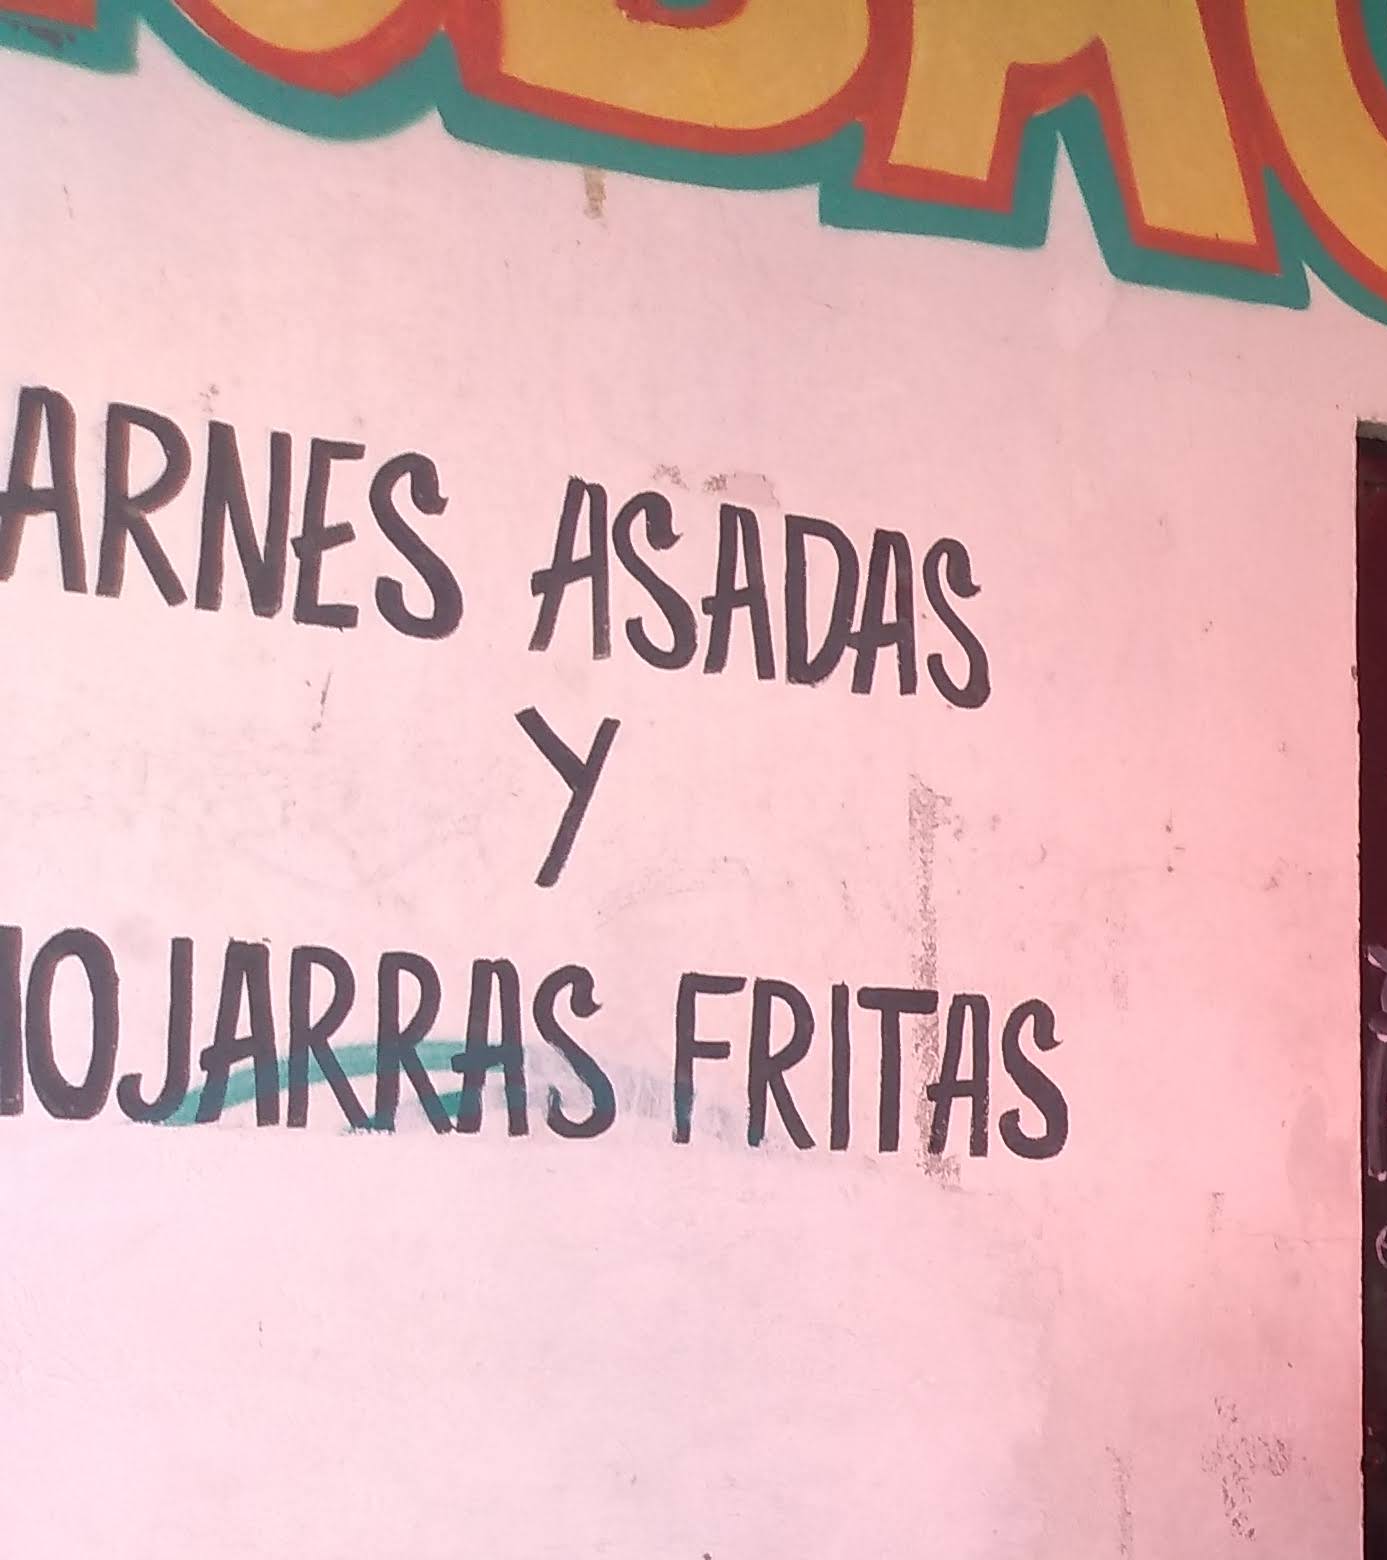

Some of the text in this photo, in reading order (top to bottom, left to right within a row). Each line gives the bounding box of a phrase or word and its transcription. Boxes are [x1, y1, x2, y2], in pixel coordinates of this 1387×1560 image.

[529, 474, 992, 709] ASADAS
[514, 706, 620, 888] Y
[674, 972, 1070, 1162] FRITAS
